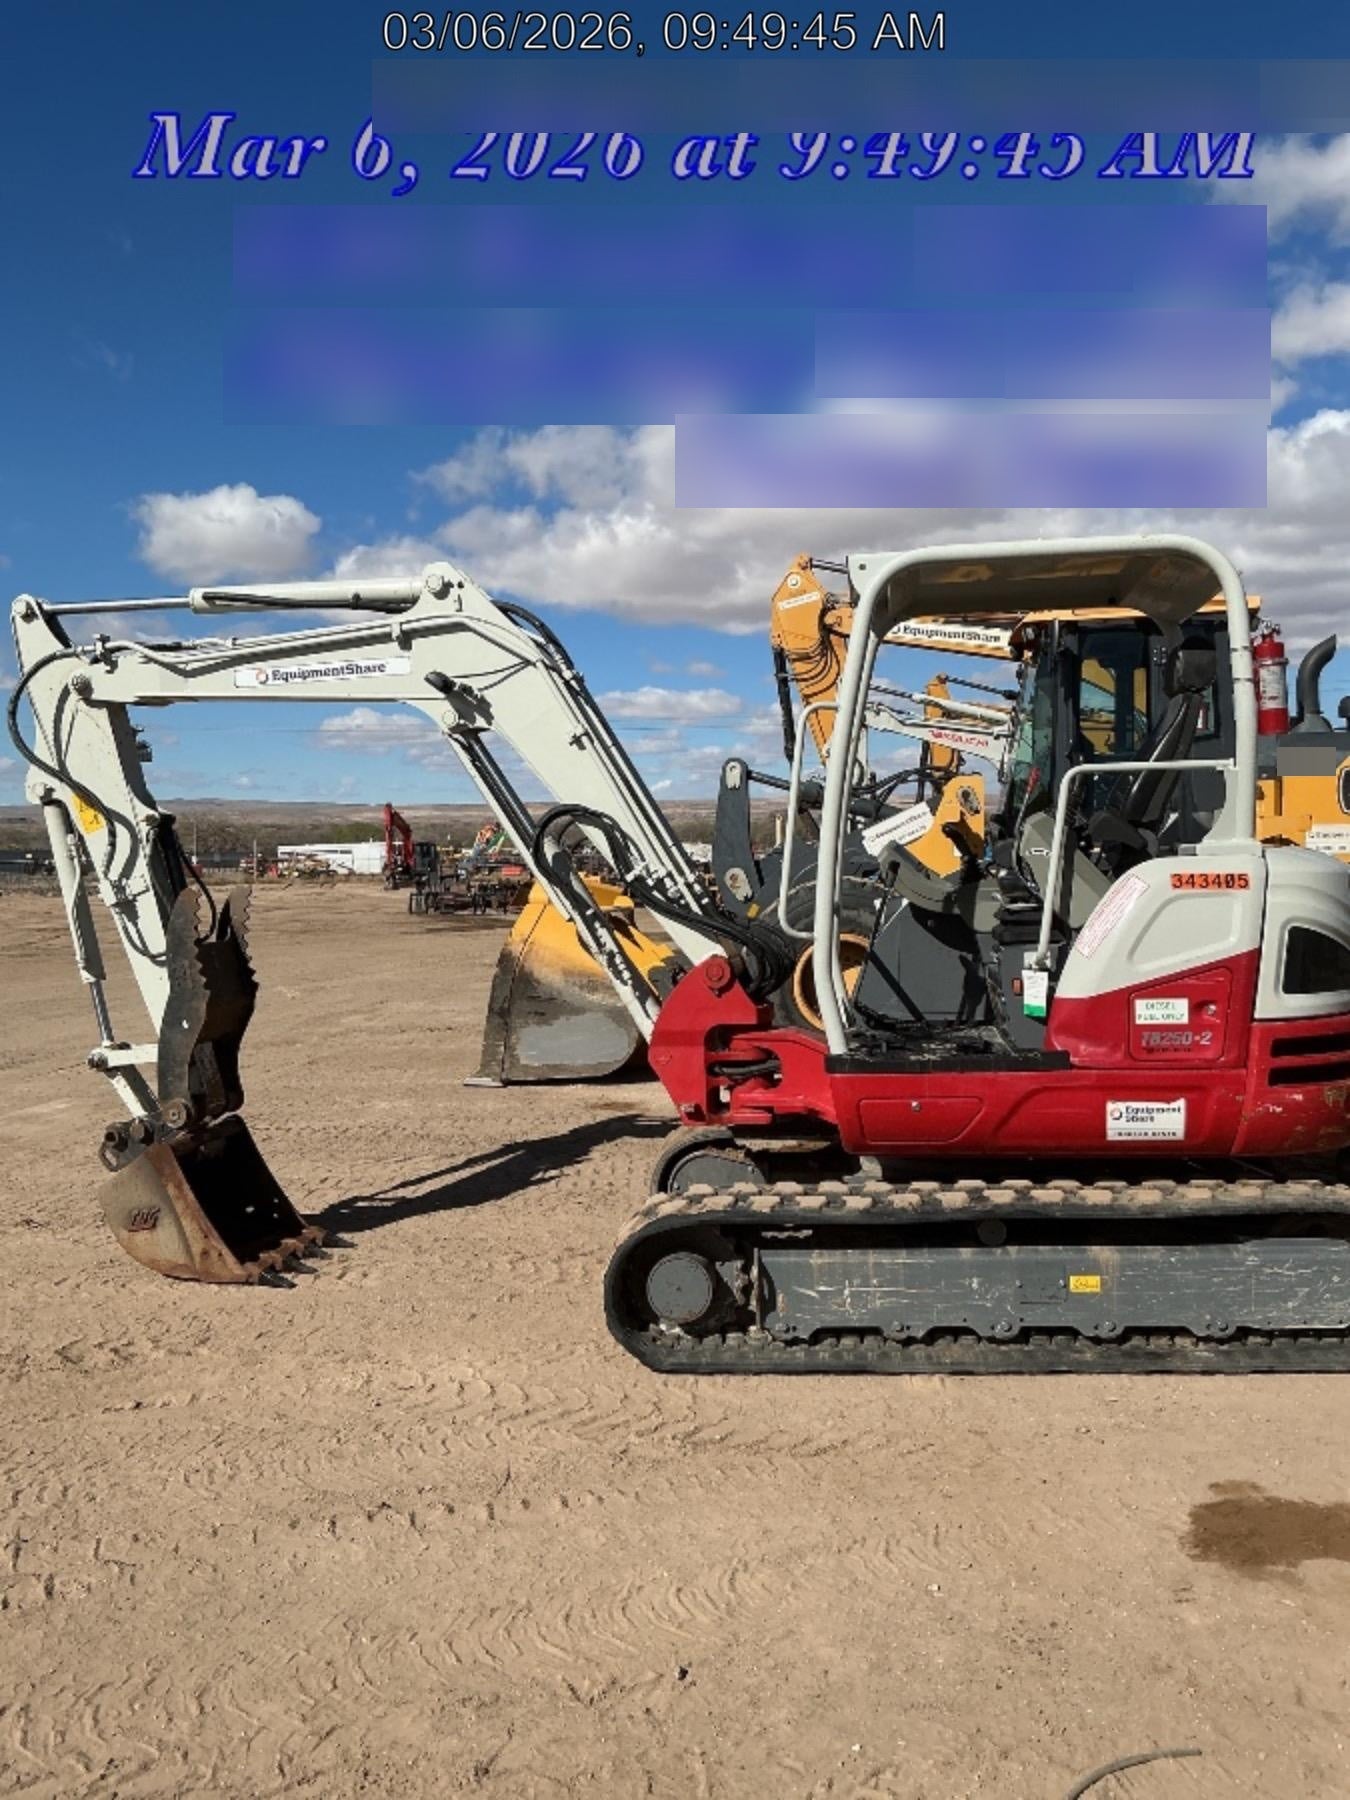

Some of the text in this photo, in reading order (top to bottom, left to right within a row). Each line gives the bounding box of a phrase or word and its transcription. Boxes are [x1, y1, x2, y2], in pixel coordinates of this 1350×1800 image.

[272, 662, 386, 682] EquipmentShare
[1171, 873, 1249, 889] 343405
[1146, 1002, 1175, 1010] DIESEL
[1142, 1031, 1212, 1047] TB250-2
[1125, 1106, 1181, 1114] Equipment
